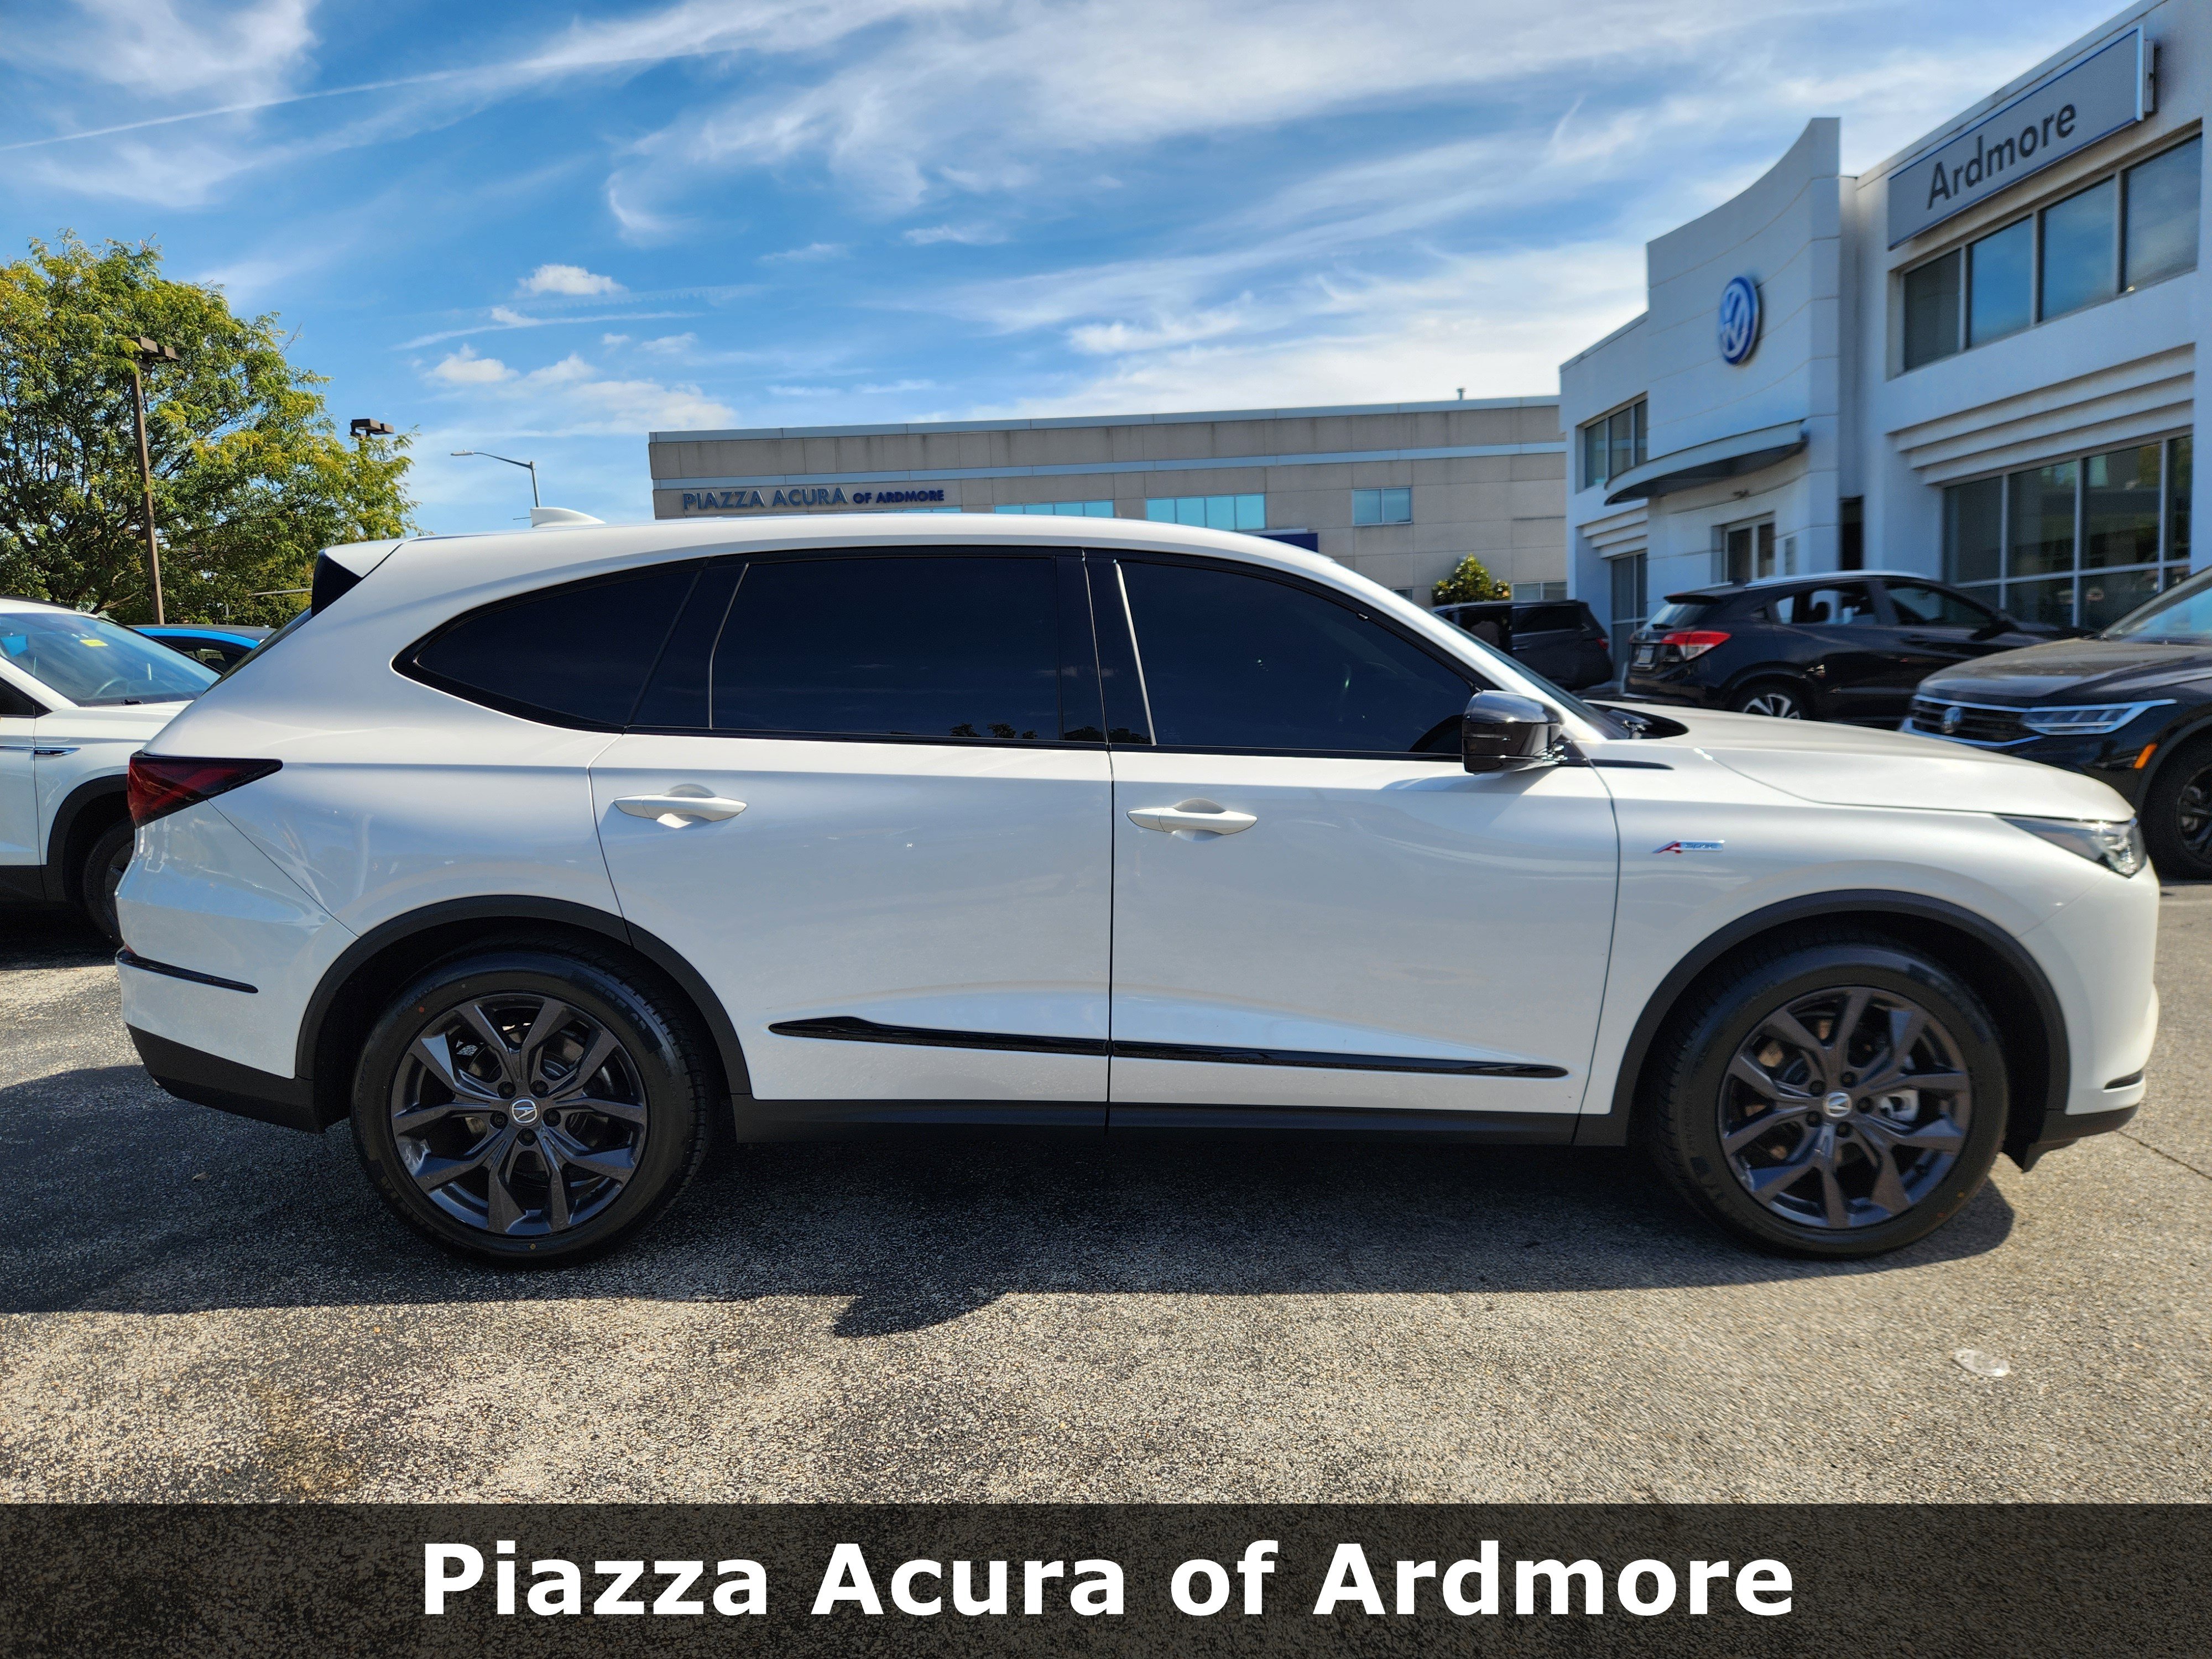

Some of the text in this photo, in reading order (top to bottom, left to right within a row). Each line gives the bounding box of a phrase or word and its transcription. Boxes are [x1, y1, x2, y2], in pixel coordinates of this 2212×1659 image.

[1927, 103, 2077, 210] Ardmore
[683, 487, 944, 510] PIAZZA ACURA OF ARDMORE
